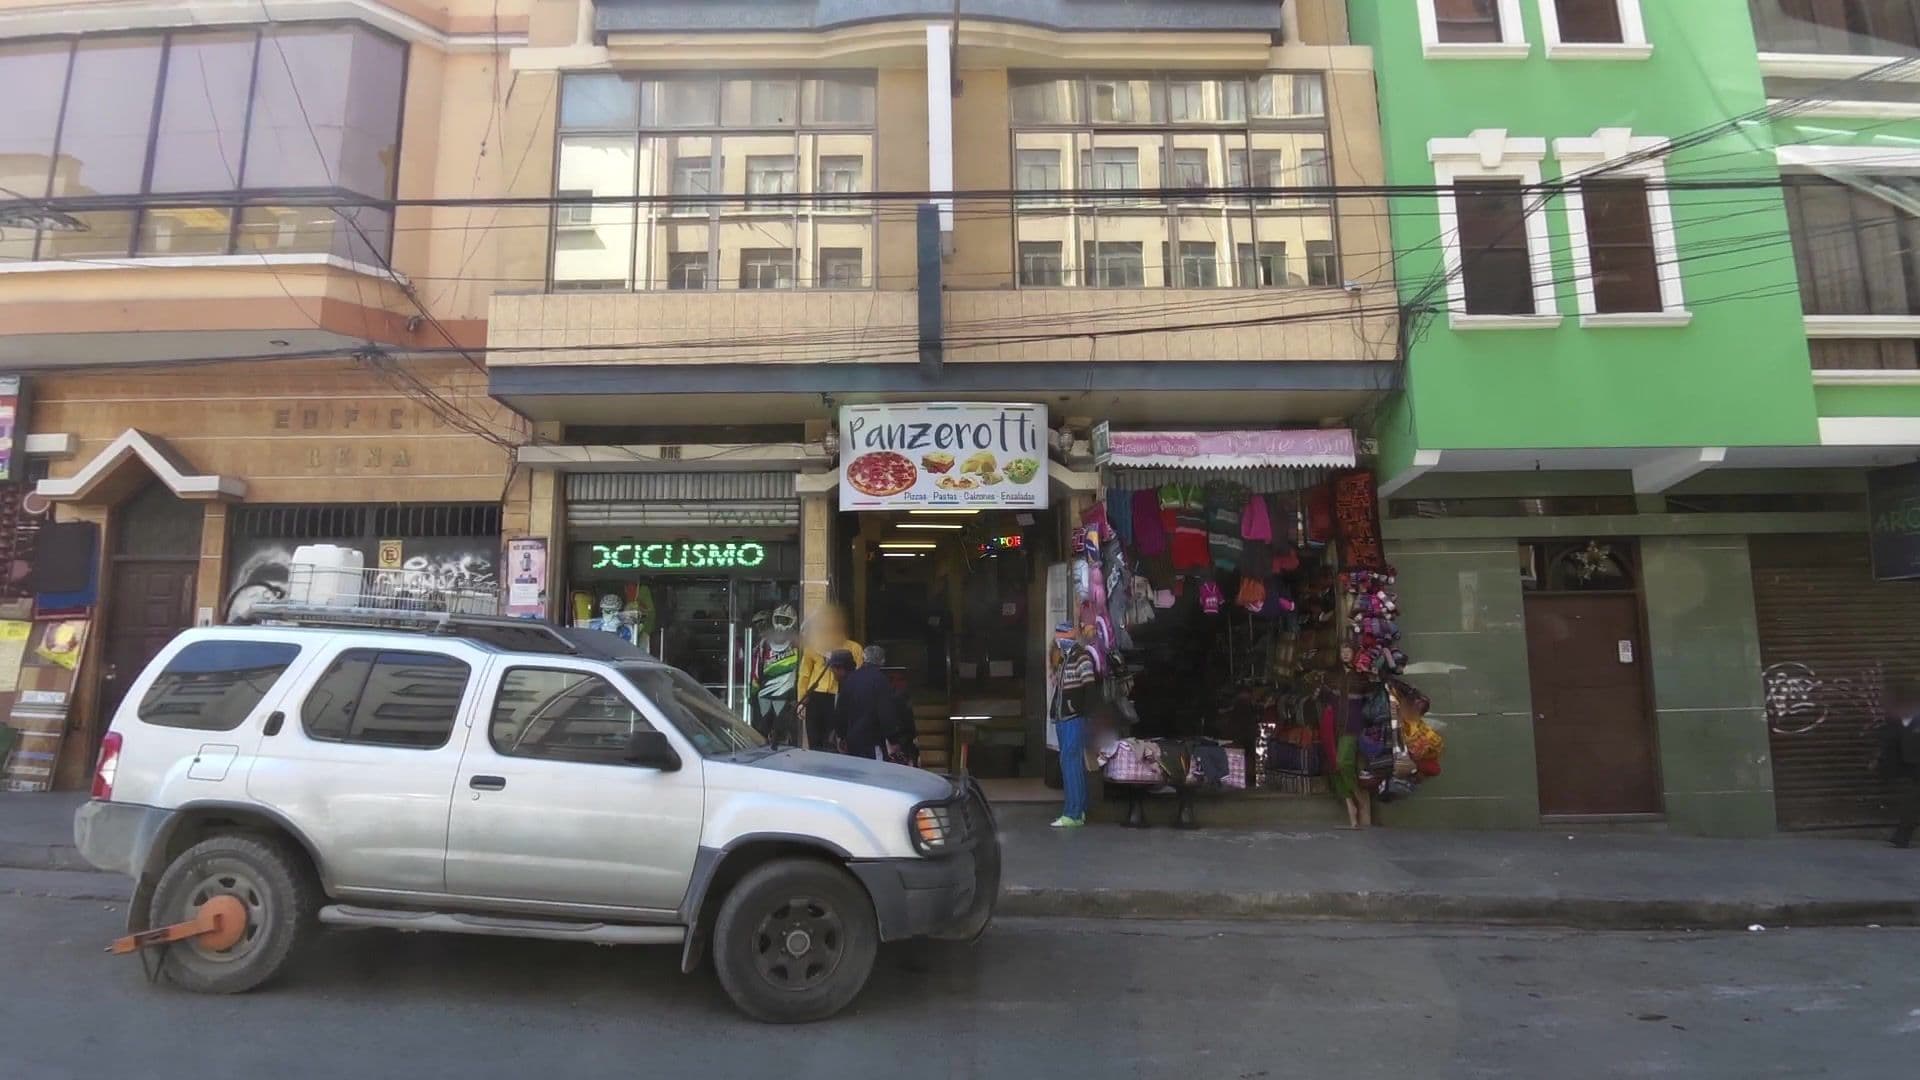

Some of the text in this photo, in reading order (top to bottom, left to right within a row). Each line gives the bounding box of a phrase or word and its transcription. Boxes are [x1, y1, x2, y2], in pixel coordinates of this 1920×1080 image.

[849, 411, 1037, 452] Panzerotti
[904, 491, 1035, 501] Pizzas Pastas Calzones Ensaladas
